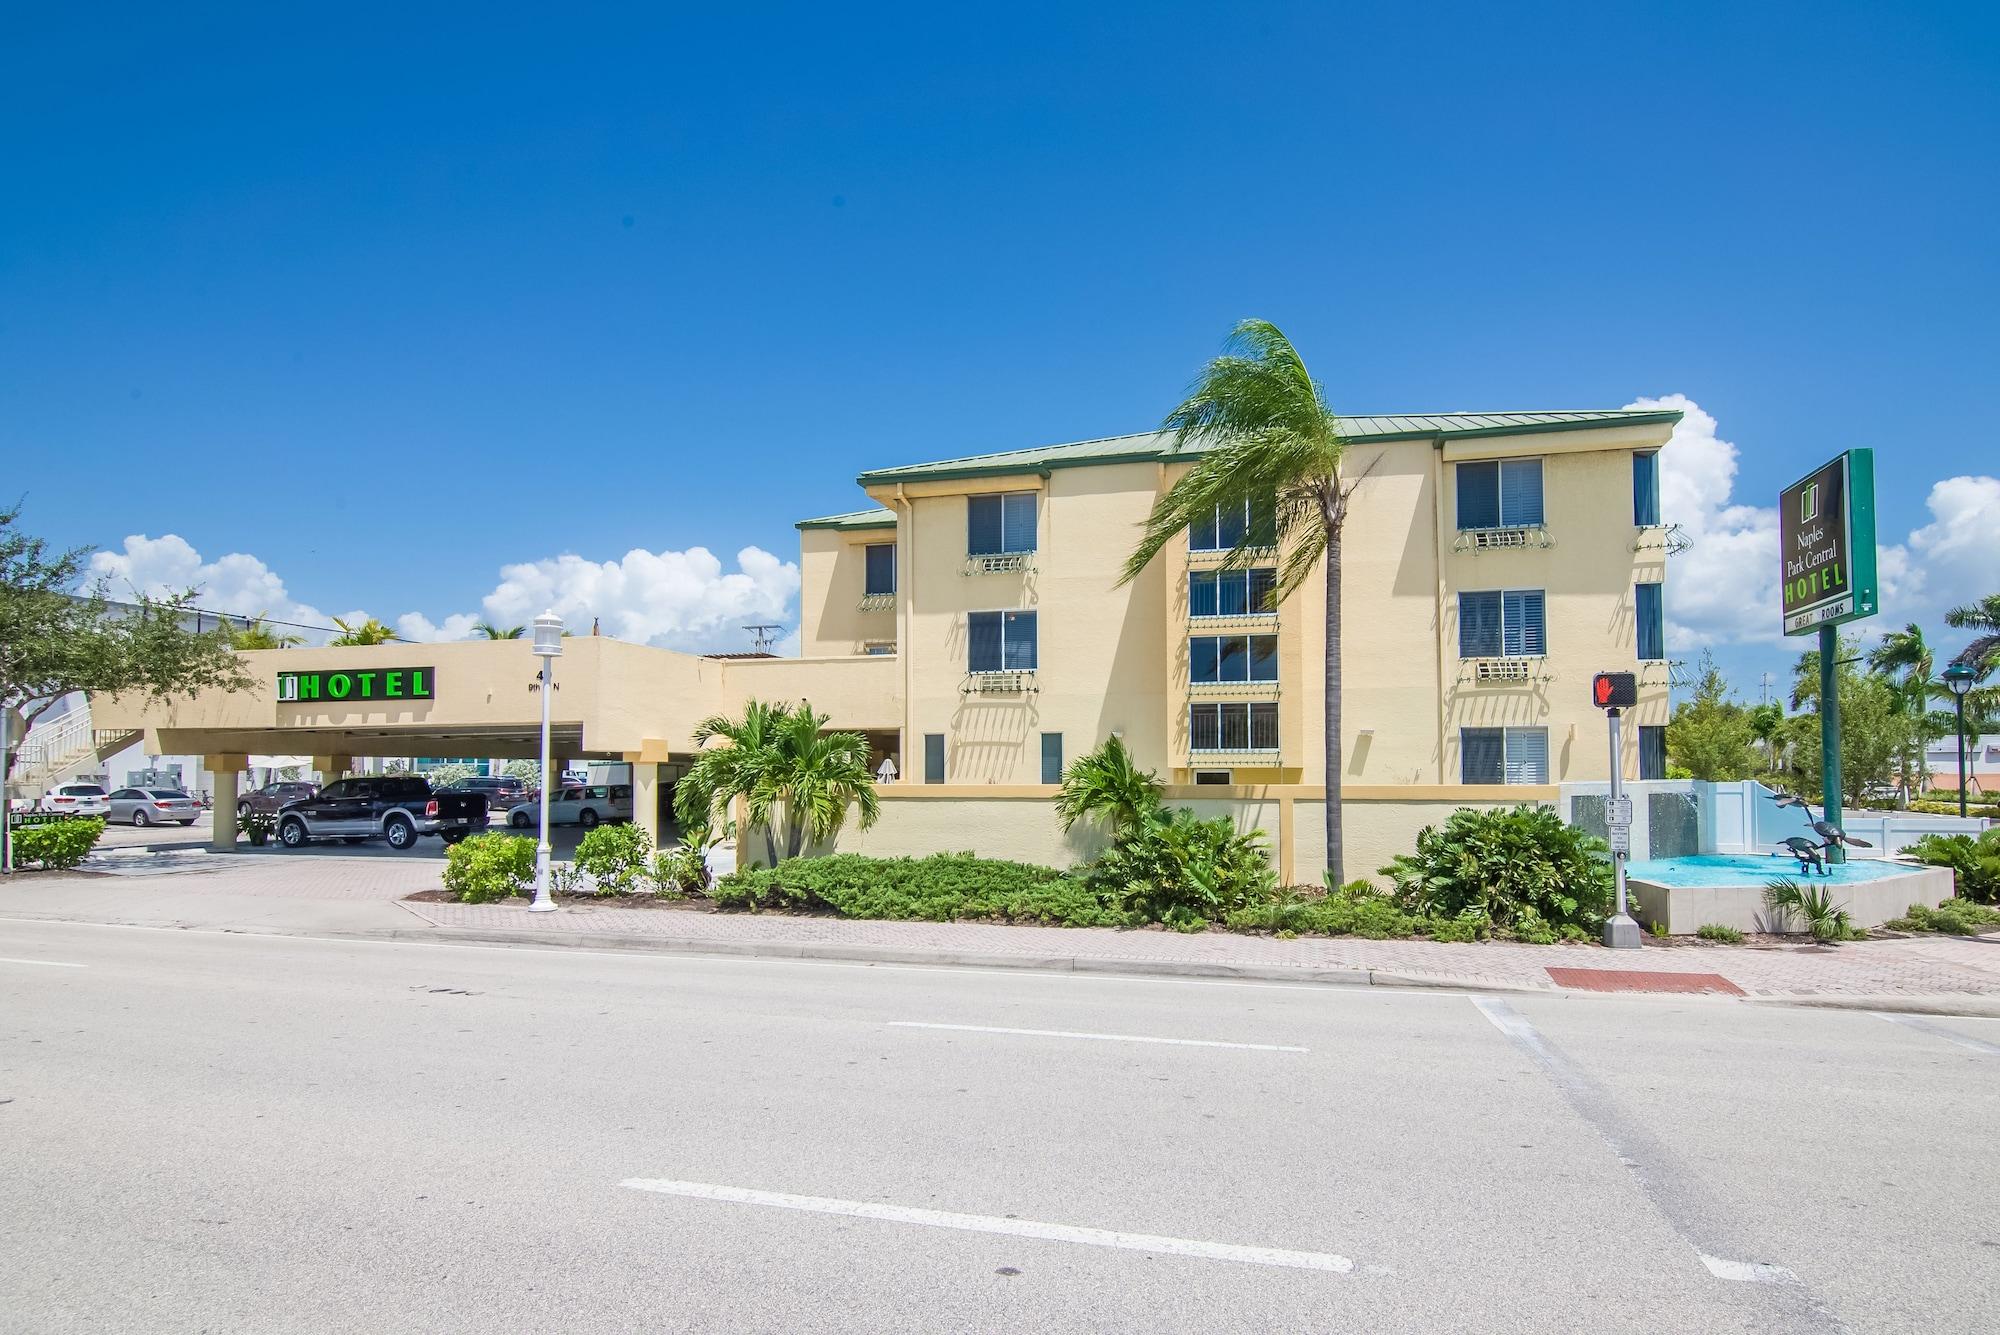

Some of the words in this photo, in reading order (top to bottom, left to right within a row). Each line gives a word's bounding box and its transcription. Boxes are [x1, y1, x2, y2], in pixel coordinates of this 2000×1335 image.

[1797, 524, 1824, 550] Naples
[1787, 555, 1805, 578] Park
[1805, 539, 1837, 569] Central
[1784, 563, 1843, 605] HOTEL
[1794, 613, 1813, 628] GREAT
[1821, 602, 1844, 620] ROOMS
[300, 671, 430, 699] HOTEL
[536, 670, 552, 681] 4
[553, 682, 560, 691] N
